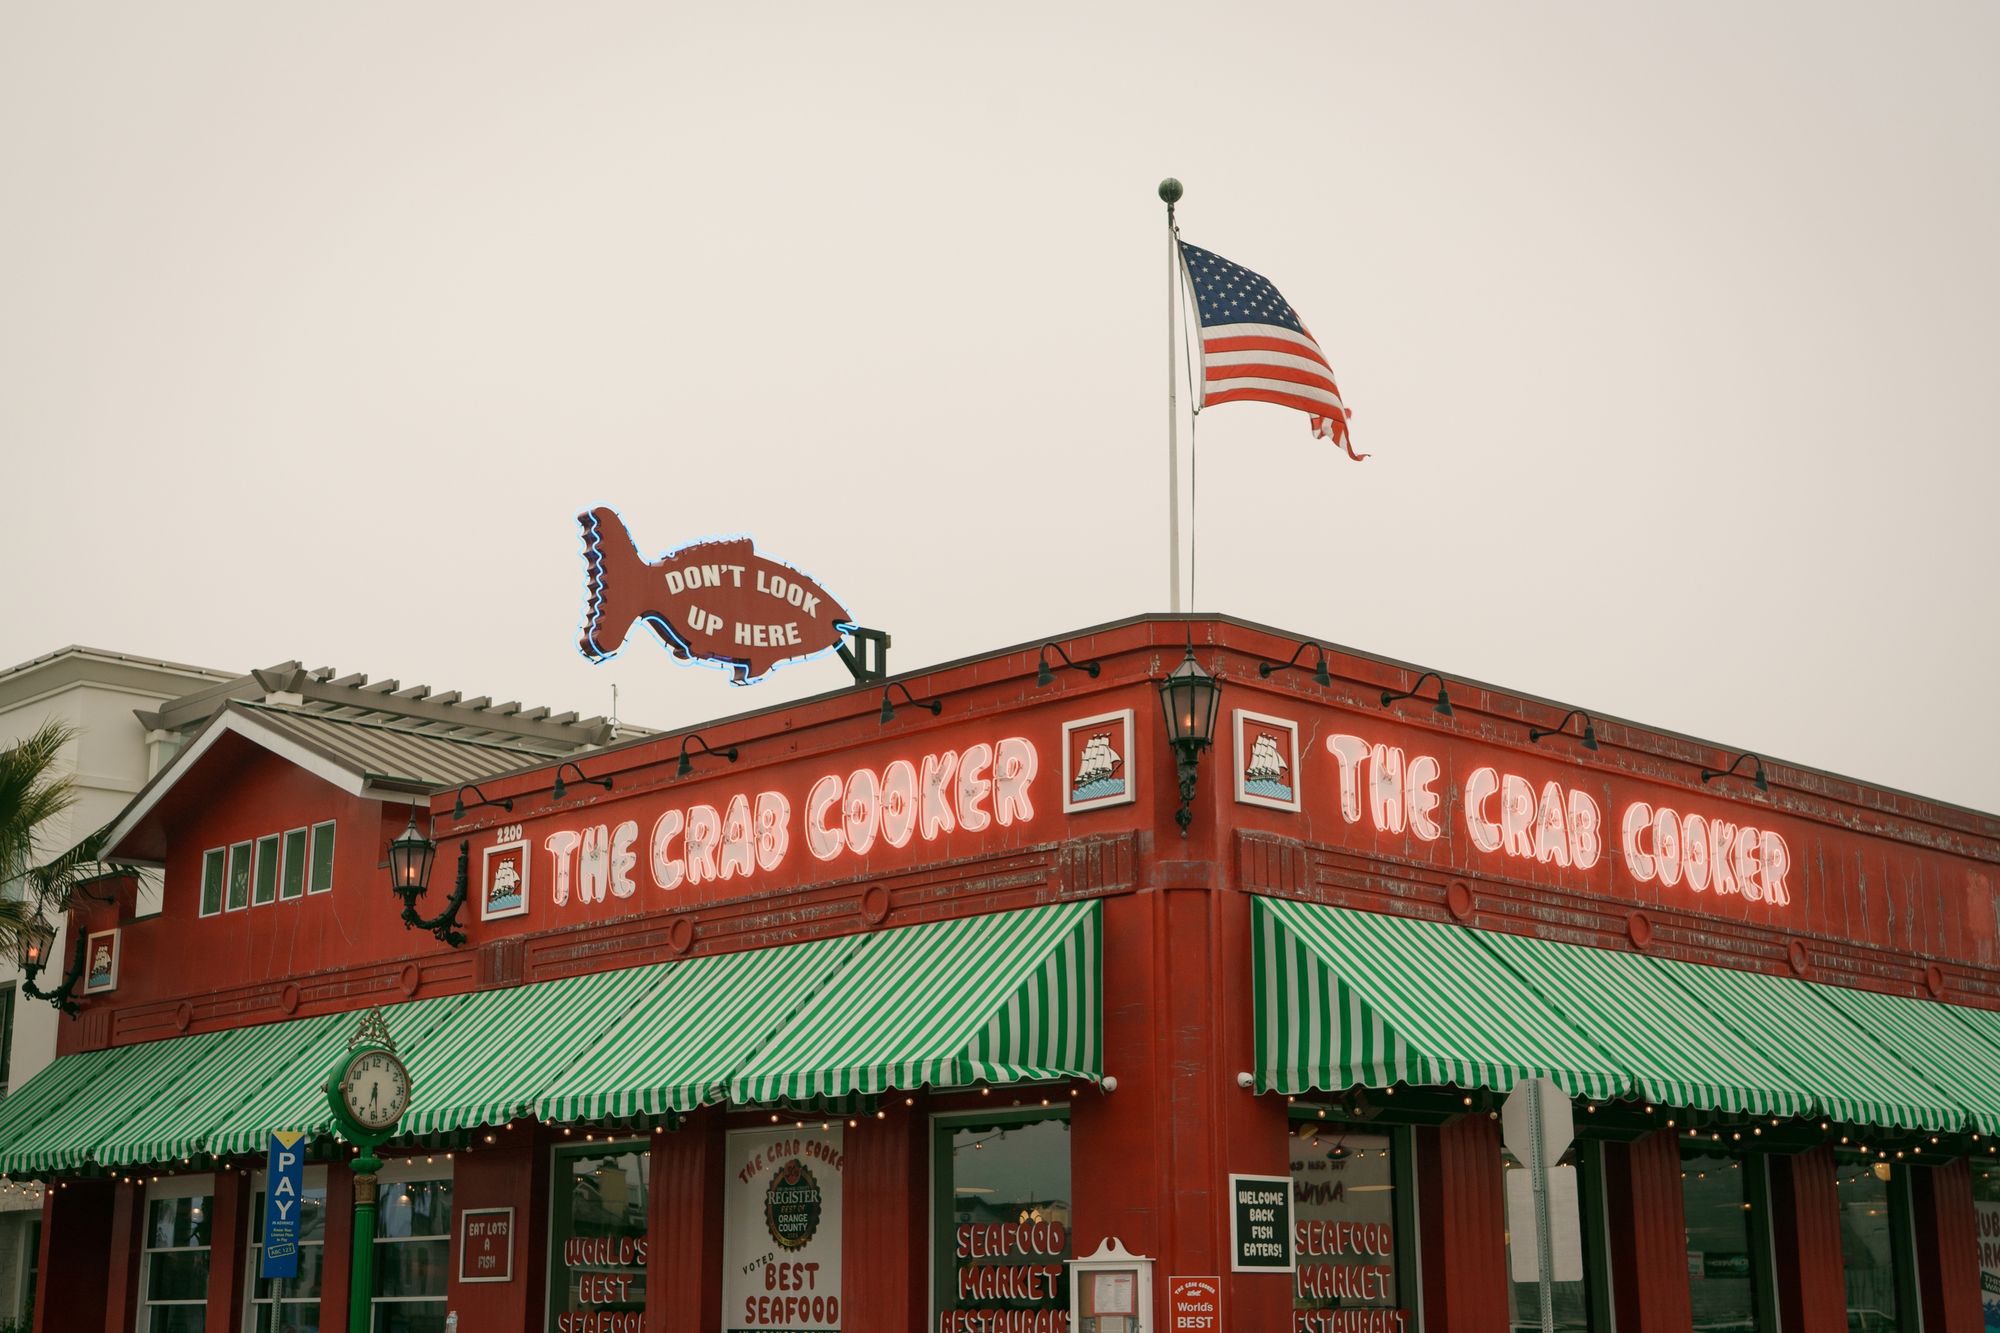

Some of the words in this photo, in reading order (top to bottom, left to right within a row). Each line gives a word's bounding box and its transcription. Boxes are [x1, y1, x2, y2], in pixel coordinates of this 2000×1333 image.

[665, 565, 745, 595] DON'T
[756, 570, 822, 618] LOOK
[687, 605, 724, 636] UP
[735, 622, 802, 647] HERE
[544, 820, 639, 907] THE
[649, 791, 791, 891] CRAB
[804, 736, 1040, 862] COOKER
[1326, 733, 1441, 842] THE
[1465, 766, 1602, 871] CRAB
[1620, 800, 1791, 906] COOKER
[497, 824, 522, 844] 2200
[362, 1061, 369, 1071] 11
[372, 1057, 382, 1067] 12
[386, 1063, 390, 1072] 1
[353, 1070, 362, 1080] 10
[392, 1072, 398, 1082] 2
[348, 1083, 354, 1093] 9
[396, 1086, 401, 1096] 3
[351, 1097, 357, 1106] 8
[390, 1100, 396, 1109] 4
[359, 1107, 365, 1116] 7
[370, 1110, 376, 1120] 6
[382, 1108, 388, 1118] 5
[738, 1154, 763, 1185] THE
[766, 1139, 800, 1163] CRAB
[805, 1139, 844, 1171] COOKE
[767, 1189, 819, 1205] REGISTER
[1239, 1190, 1284, 1206] WELCOME
[778, 1214, 808, 1223] ORANGE
[1249, 1208, 1274, 1222] BACK
[469, 1222, 485, 1236] EAT
[487, 1221, 508, 1235] LOTS
[778, 1223, 808, 1232] COUNTY
[1252, 1225, 1273, 1239] FISH
[484, 1238, 490, 1251] A
[956, 1221, 1066, 1258] SEAFOOD
[1295, 1219, 1393, 1257] SEAFOOD
[1243, 1243, 1282, 1258] EATERS!
[478, 1255, 496, 1269] FISH
[742, 1252, 774, 1275] VOTED
[765, 1262, 819, 1291] BEST
[958, 1263, 1063, 1300] MARKET
[1297, 1263, 1393, 1300] MARKET
[579, 1274, 634, 1304] BEST
[745, 1295, 839, 1325] SEAFOOD
[940, 1308, 1071, 1333] RESTAURAN
[1177, 1316, 1214, 1328] BEST
